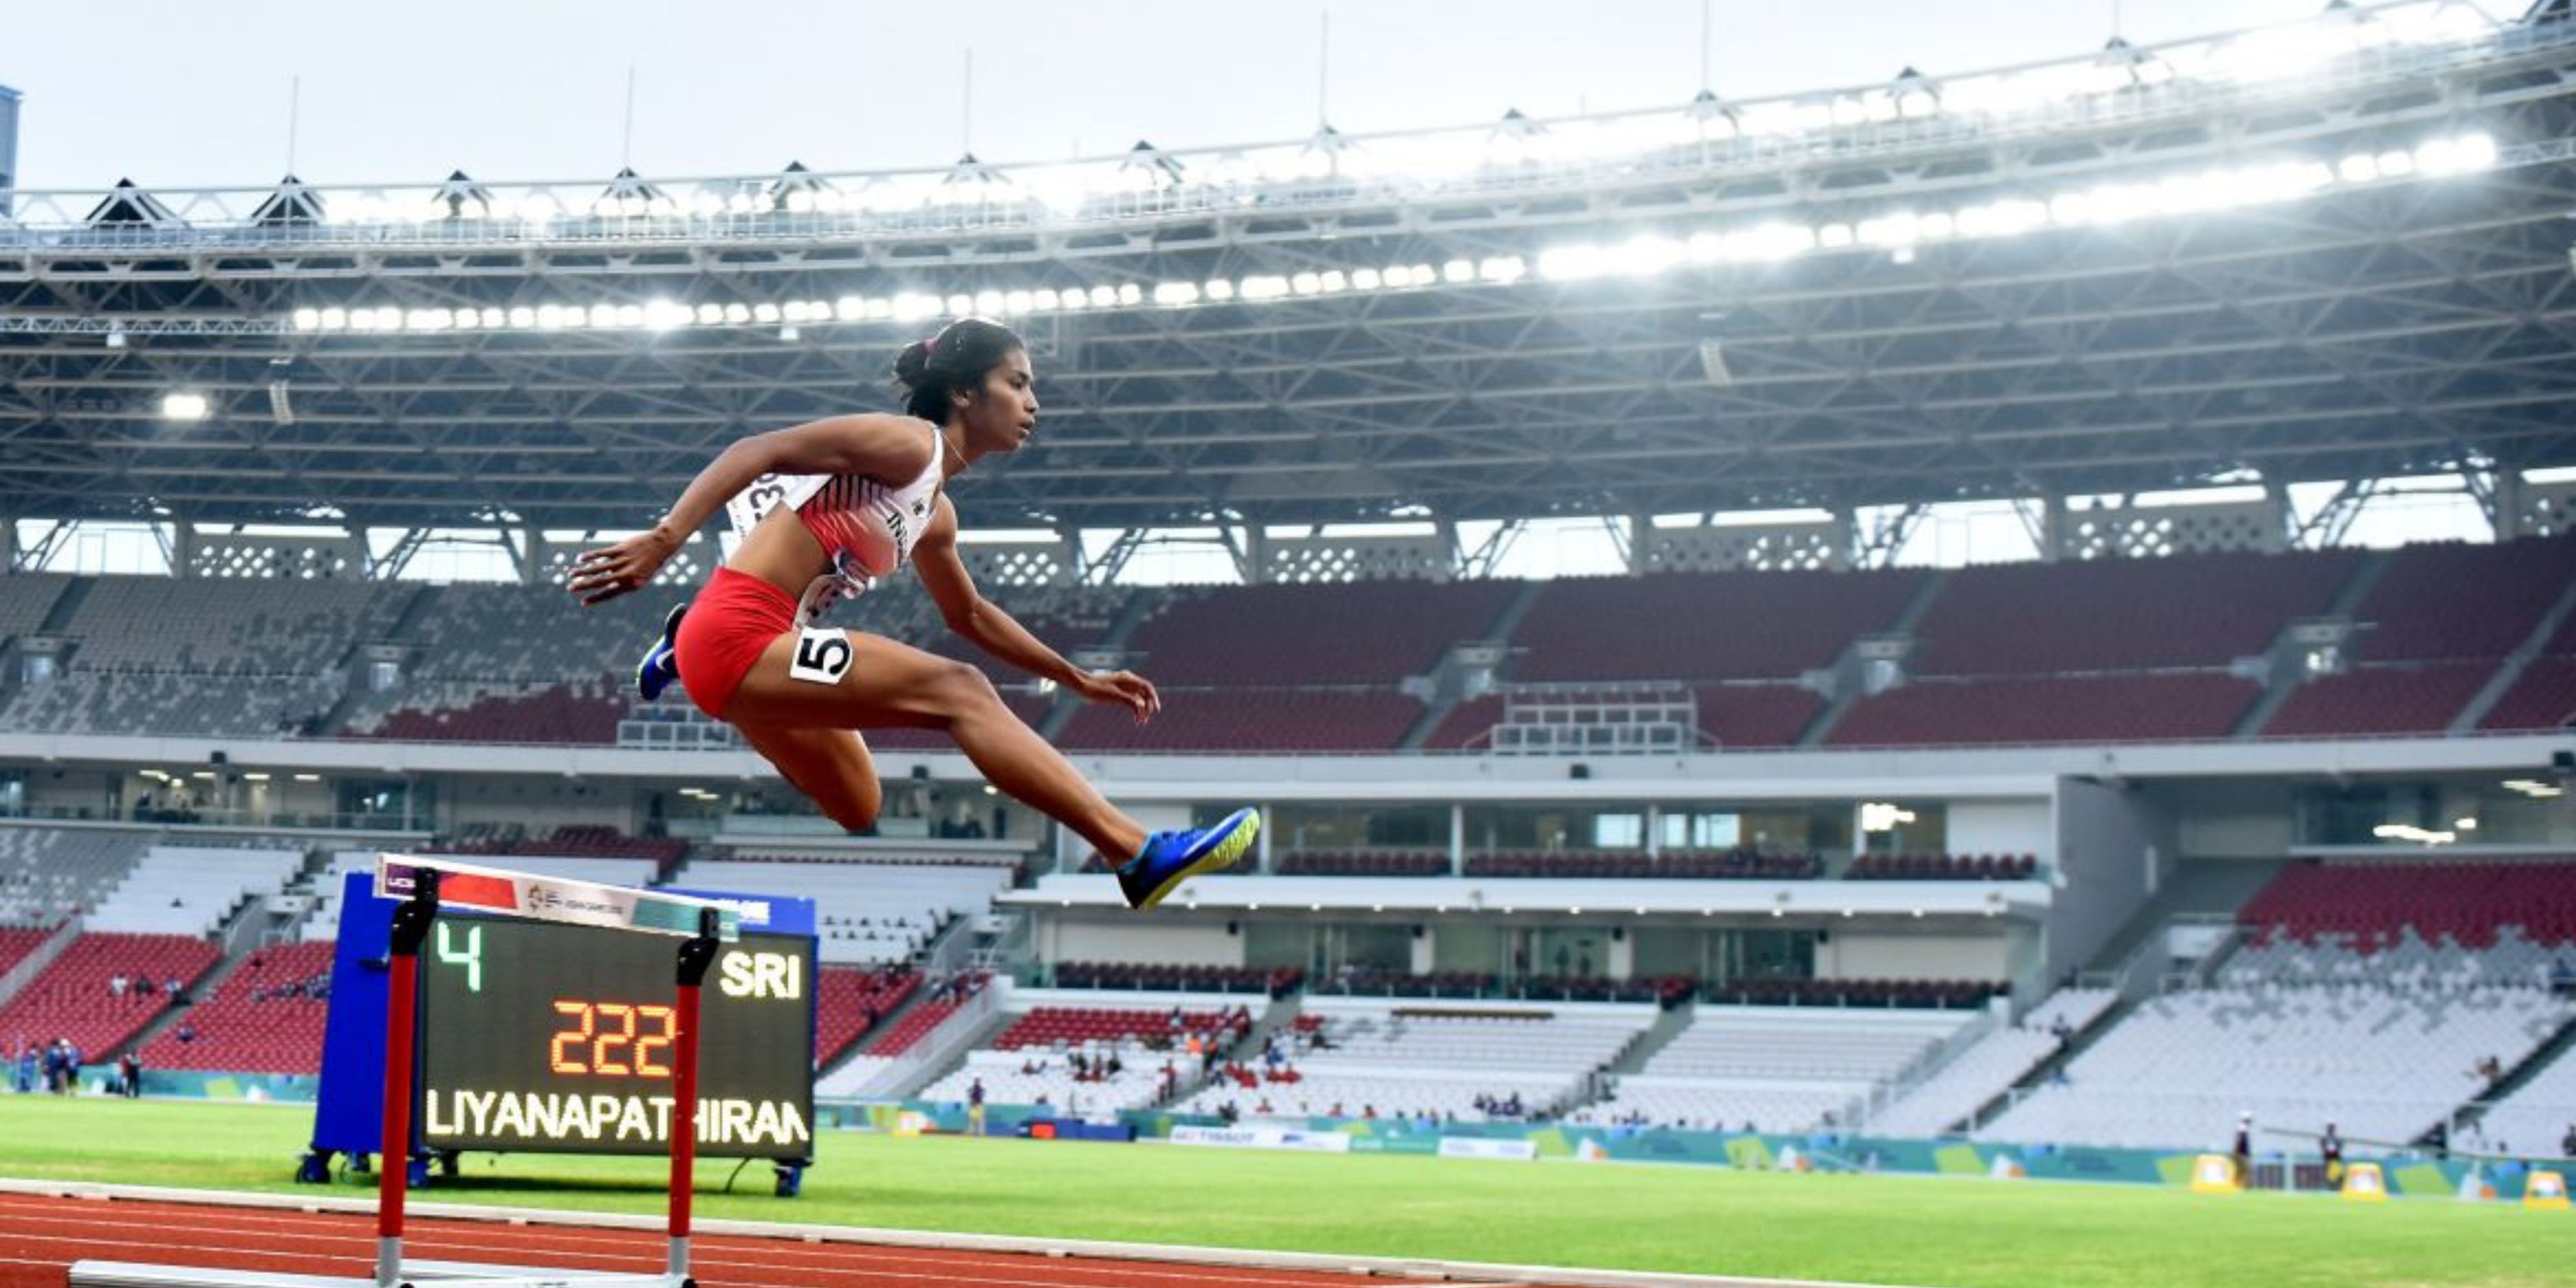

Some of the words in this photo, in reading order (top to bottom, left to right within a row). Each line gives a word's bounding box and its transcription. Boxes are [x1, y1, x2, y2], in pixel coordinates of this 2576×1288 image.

[797, 637, 850, 675] 5
[438, 921, 481, 992] 4
[719, 951, 801, 999] SRI
[551, 1001, 677, 1077] 222
